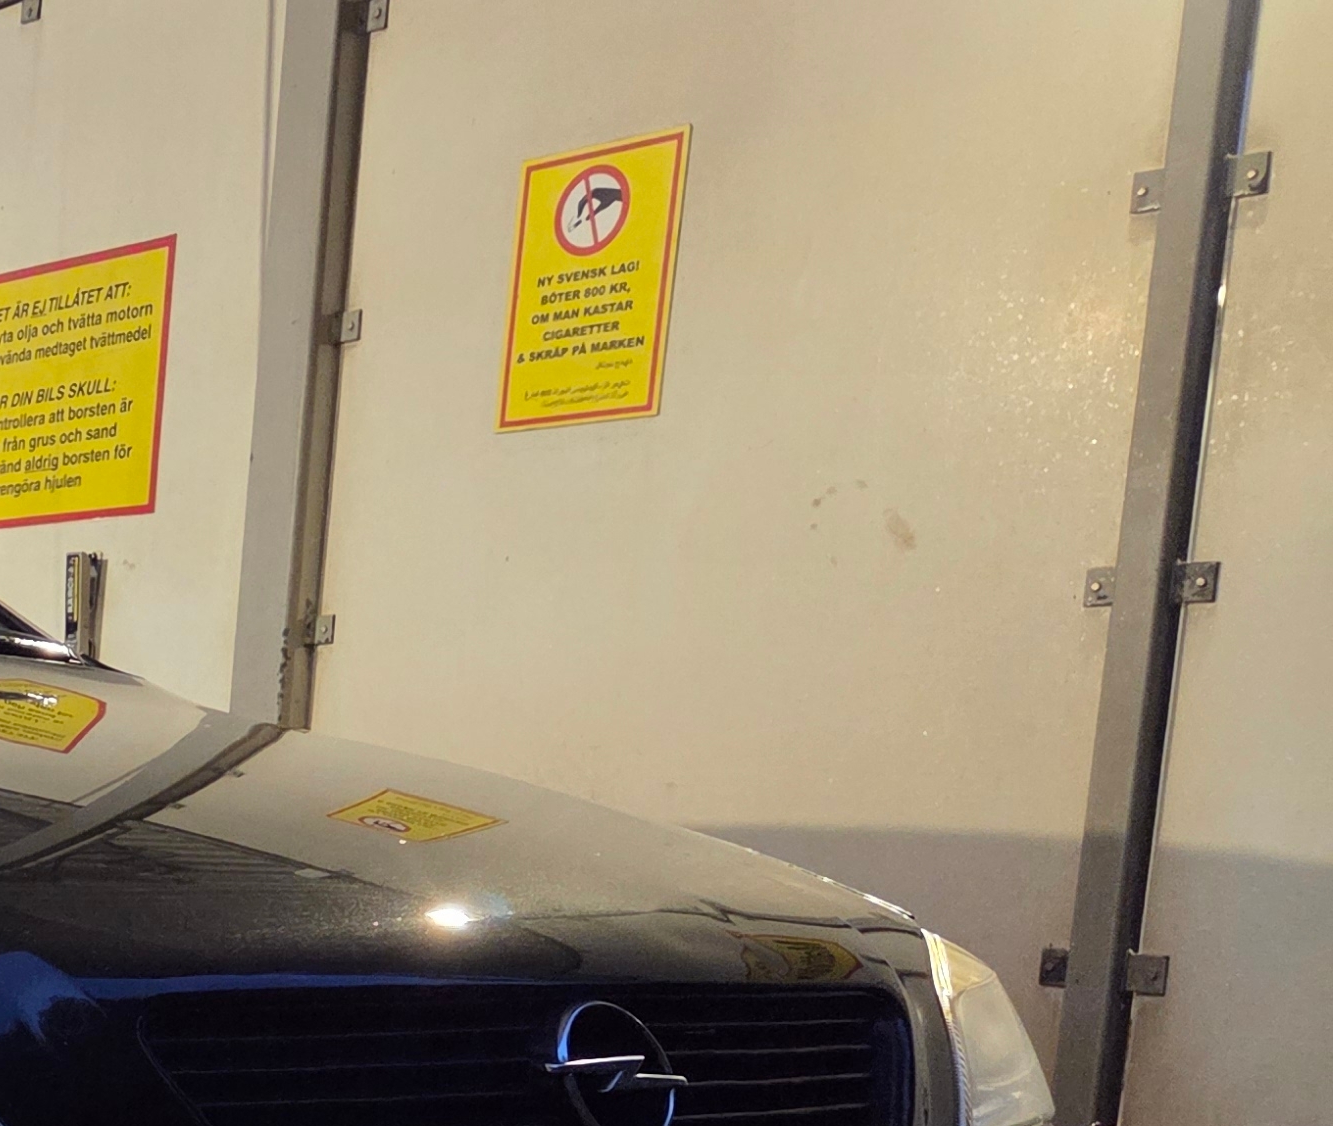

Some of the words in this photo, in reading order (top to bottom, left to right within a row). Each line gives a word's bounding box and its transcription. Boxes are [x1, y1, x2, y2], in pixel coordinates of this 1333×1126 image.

[537, 275, 554, 288] NY
[556, 266, 608, 284] SVENSK
[610, 260, 640, 275] LAG!
[12, 300, 29, 320] ÄR
[31, 298, 47, 316] EJ
[49, 287, 104, 313] TILLÅTET
[104, 281, 132, 301] ATT:
[540, 289, 581, 306] BÖTER
[584, 284, 606, 299] 800
[609, 281, 631, 294] KR,
[17, 324, 38, 344] olja
[41, 321, 64, 336] och
[67, 312, 102, 331] tvätta
[106, 303, 154, 323] motorn
[531, 312, 549, 325] OM
[552, 308, 580, 322] MAN
[583, 299, 634, 317] KASTAR
[34, 338, 88, 358] medtaget
[89, 324, 152, 350] tvättmedel
[542, 320, 620, 342] CIGARETTER
[516, 353, 525, 364] &
[529, 346, 569, 362] SKRÄP
[571, 342, 587, 356] PÅ
[590, 336, 645, 354] MARKEN
[10, 391, 33, 408] DIN
[35, 384, 66, 404] BILS
[67, 377, 117, 398] SKULL:
[48, 409, 65, 424] att
[68, 401, 116, 421] borsten
[119, 397, 133, 413] är
[2, 437, 26, 452] från
[28, 433, 56, 453] grus
[59, 427, 82, 445] och
[85, 422, 118, 441] sand
[24, 453, 59, 474] aldrig
[62, 448, 110, 467] borsten
[113, 443, 133, 459] för
[44, 473, 82, 493] hjulen
